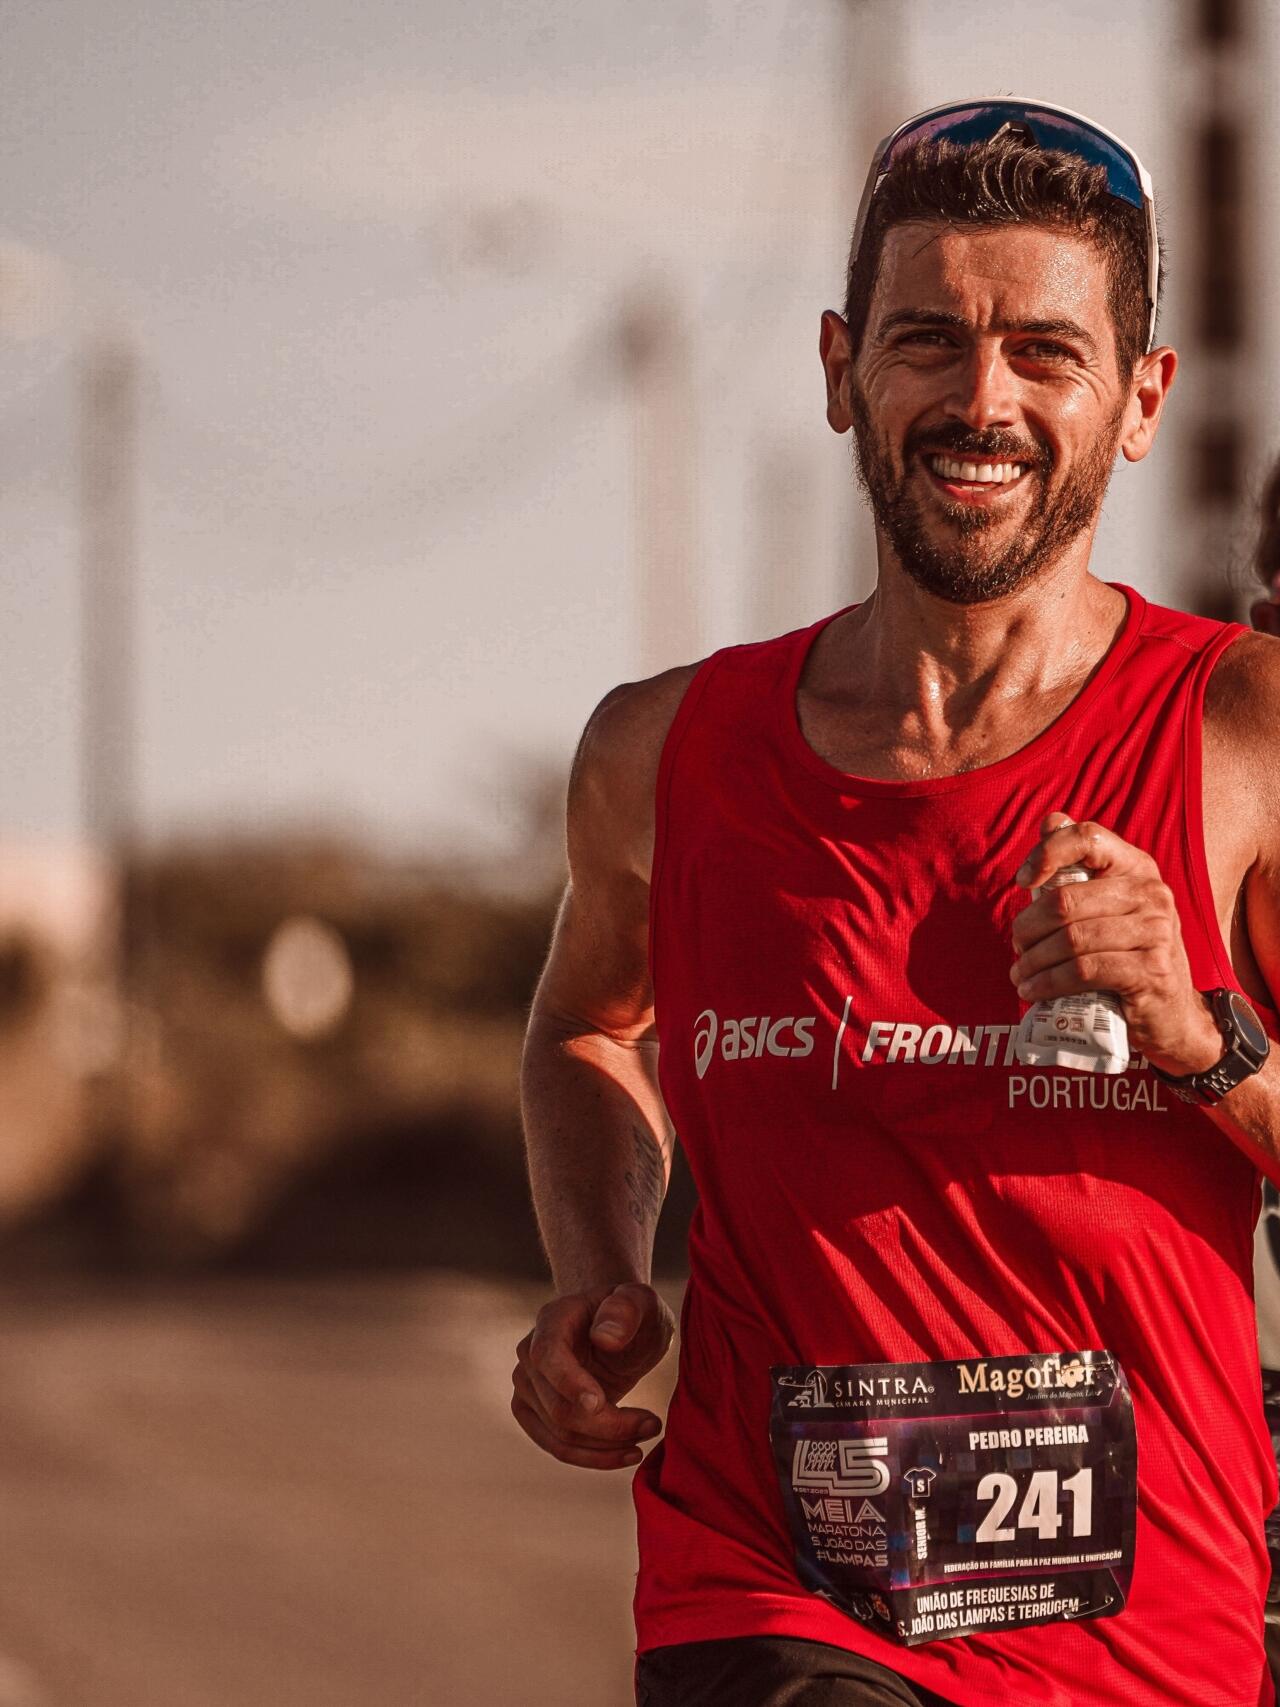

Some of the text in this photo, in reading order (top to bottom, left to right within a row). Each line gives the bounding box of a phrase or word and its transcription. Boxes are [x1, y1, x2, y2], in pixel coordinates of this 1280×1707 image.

[1008, 1074, 1168, 1113] PORTUGAL
[834, 1376, 928, 1398] SINTRA
[876, 1397, 929, 1407] MUNICIPAL
[968, 1424, 1089, 1451] PEDRO PEREIRA
[916, 1479, 925, 1493] S
[800, 1497, 887, 1523] MEIA
[975, 1467, 1093, 1544] 241
[807, 1522, 887, 1537] MARATONA
[915, 1520, 928, 1560] SENIOR
[811, 1536, 888, 1551] S. JOÃO DAS
[816, 1550, 889, 1567] #LAMPAS
[944, 1563, 979, 1574] FEDERAÇÃO
[979, 1562, 989, 1570] DA
[1016, 1559, 1033, 1568] PARA
[1039, 1558, 1051, 1567] PAZ
[1051, 1556, 1081, 1565] MUNDIAL
[1085, 1550, 1123, 1562] UNIFICAÇÃO
[916, 1583, 1055, 1614] UNIÃO DE FREGUESIAS DE
[897, 1598, 1079, 1637] S. JOÃO DAS LAMPAS E TERRUGEM
